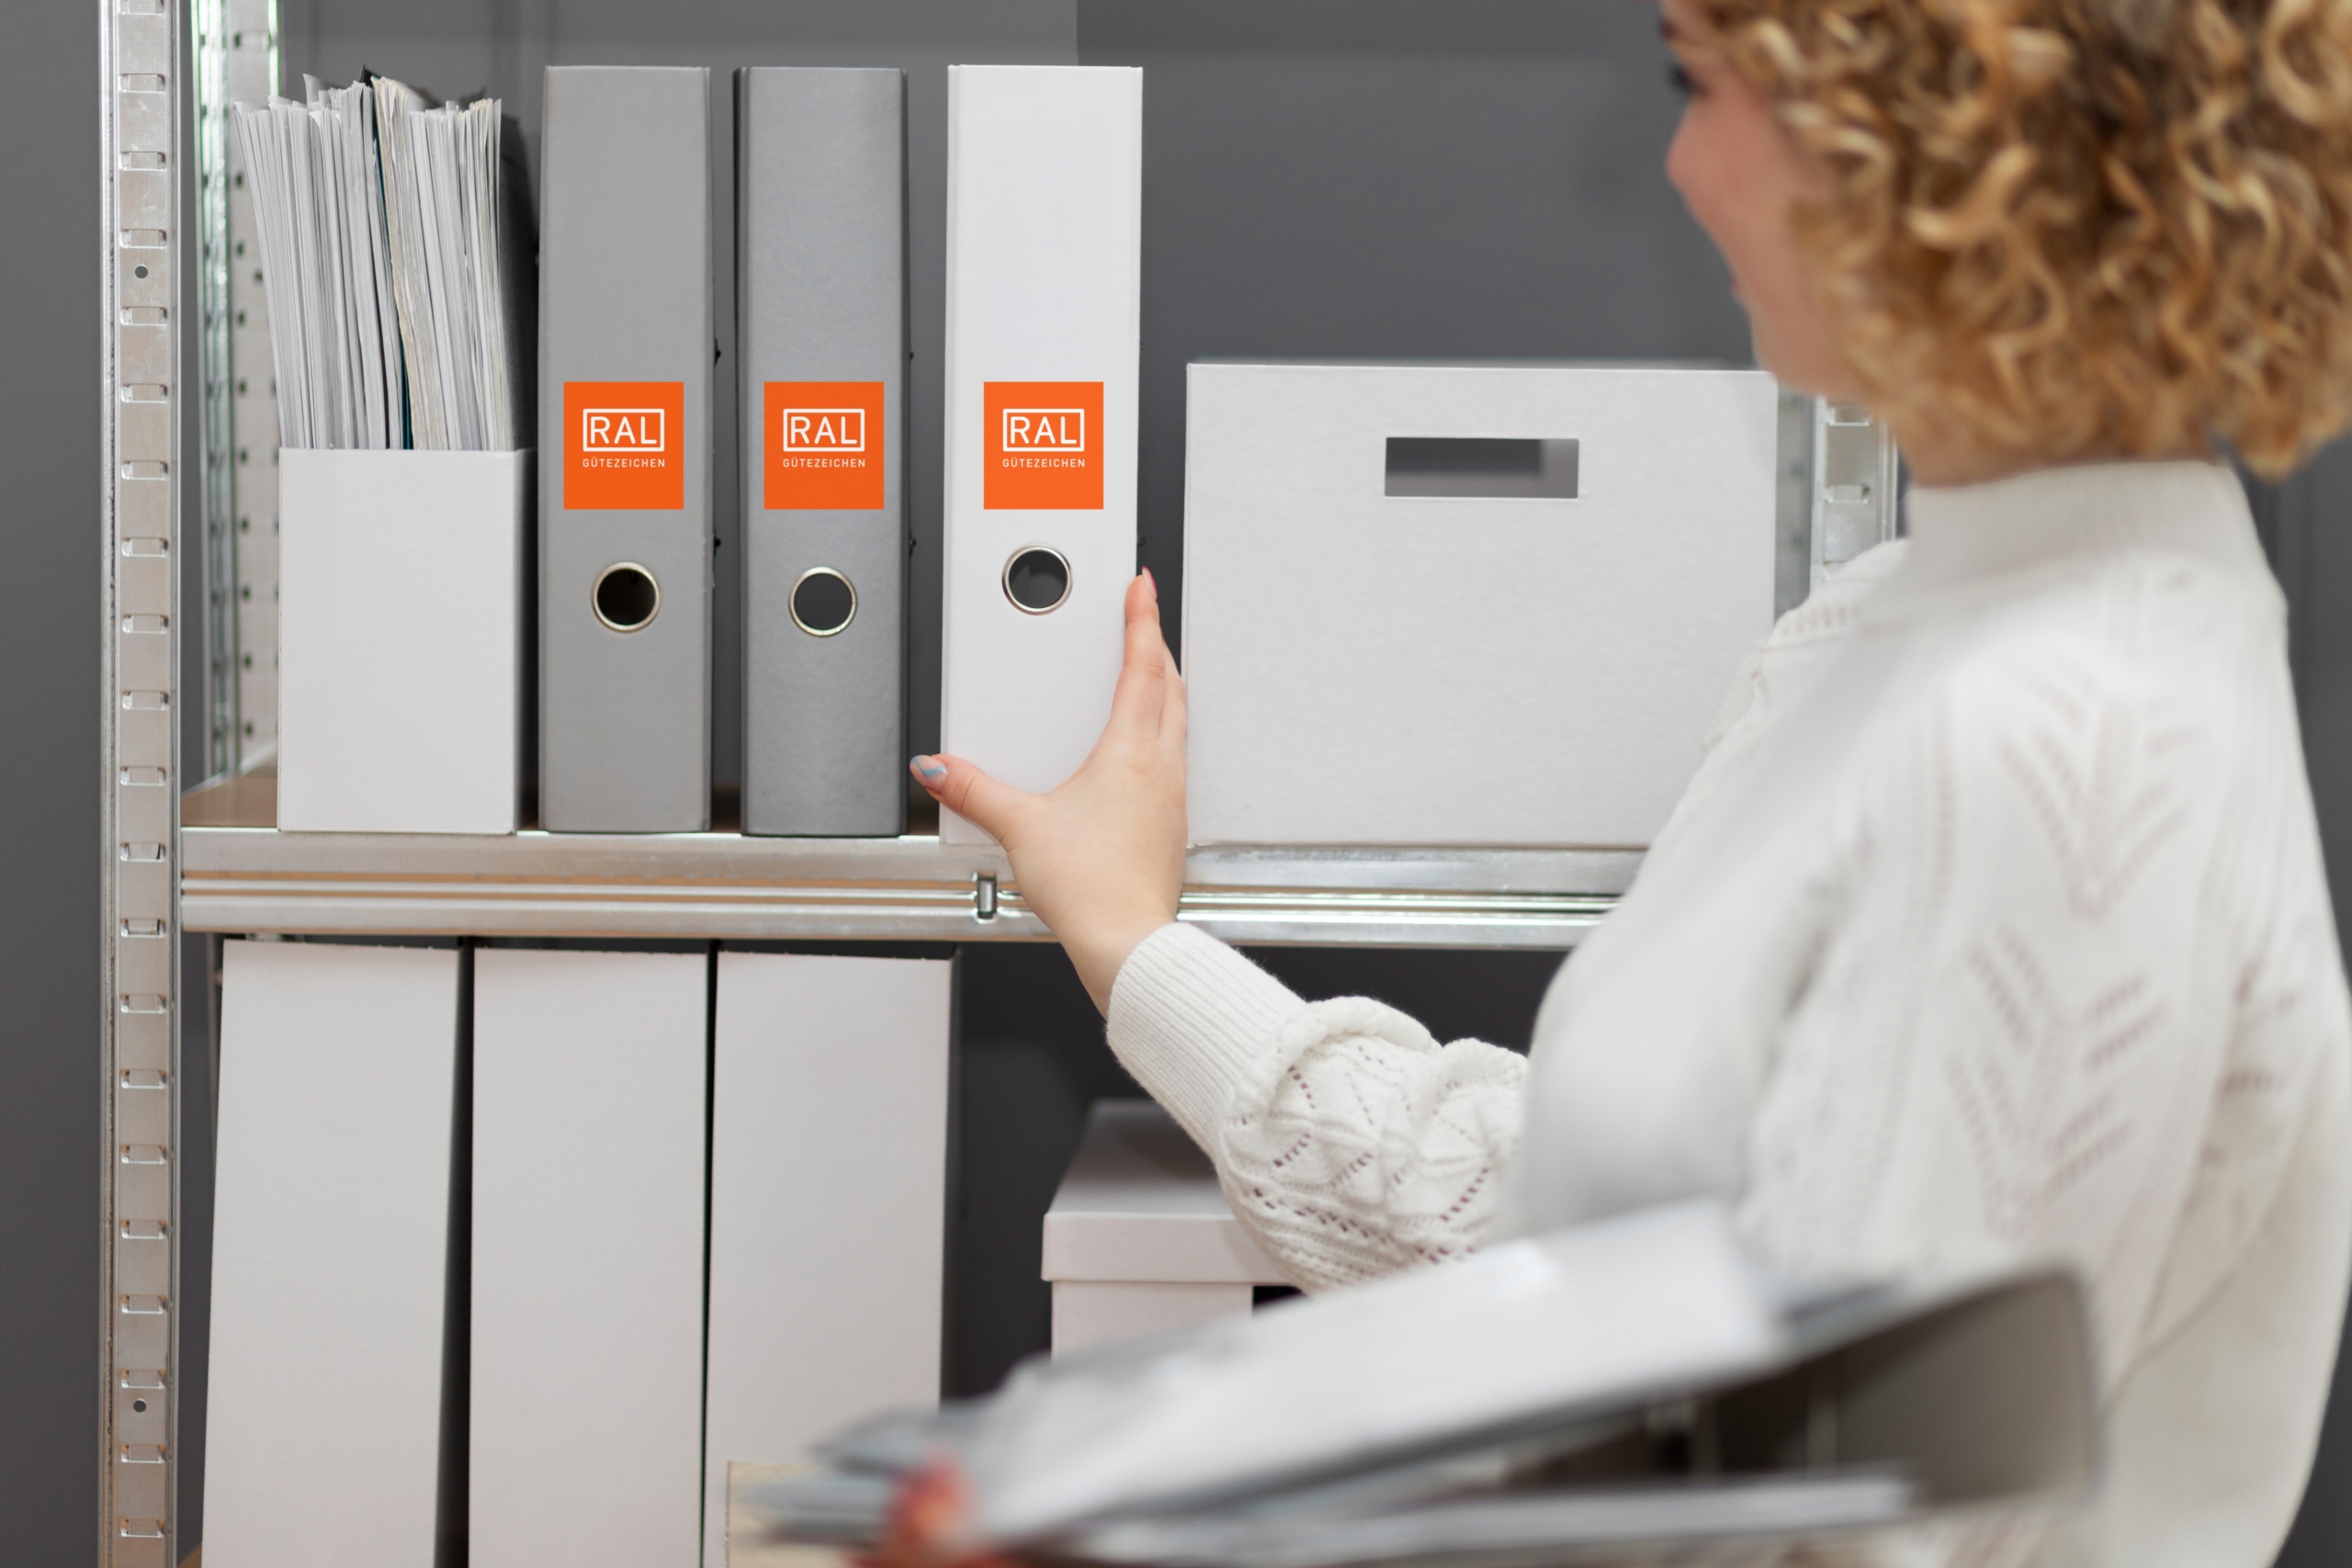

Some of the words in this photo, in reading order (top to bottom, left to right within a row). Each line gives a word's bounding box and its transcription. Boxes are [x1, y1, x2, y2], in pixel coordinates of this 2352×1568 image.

[590, 415, 658, 445] RAL
[789, 415, 857, 445] RAL
[1010, 415, 1078, 445] RAL
[582, 457, 665, 468] GÜTEZEICHEN
[782, 457, 865, 468] GÜTEZEICHEN
[1002, 457, 1085, 468] GÜTEZEICHEN
